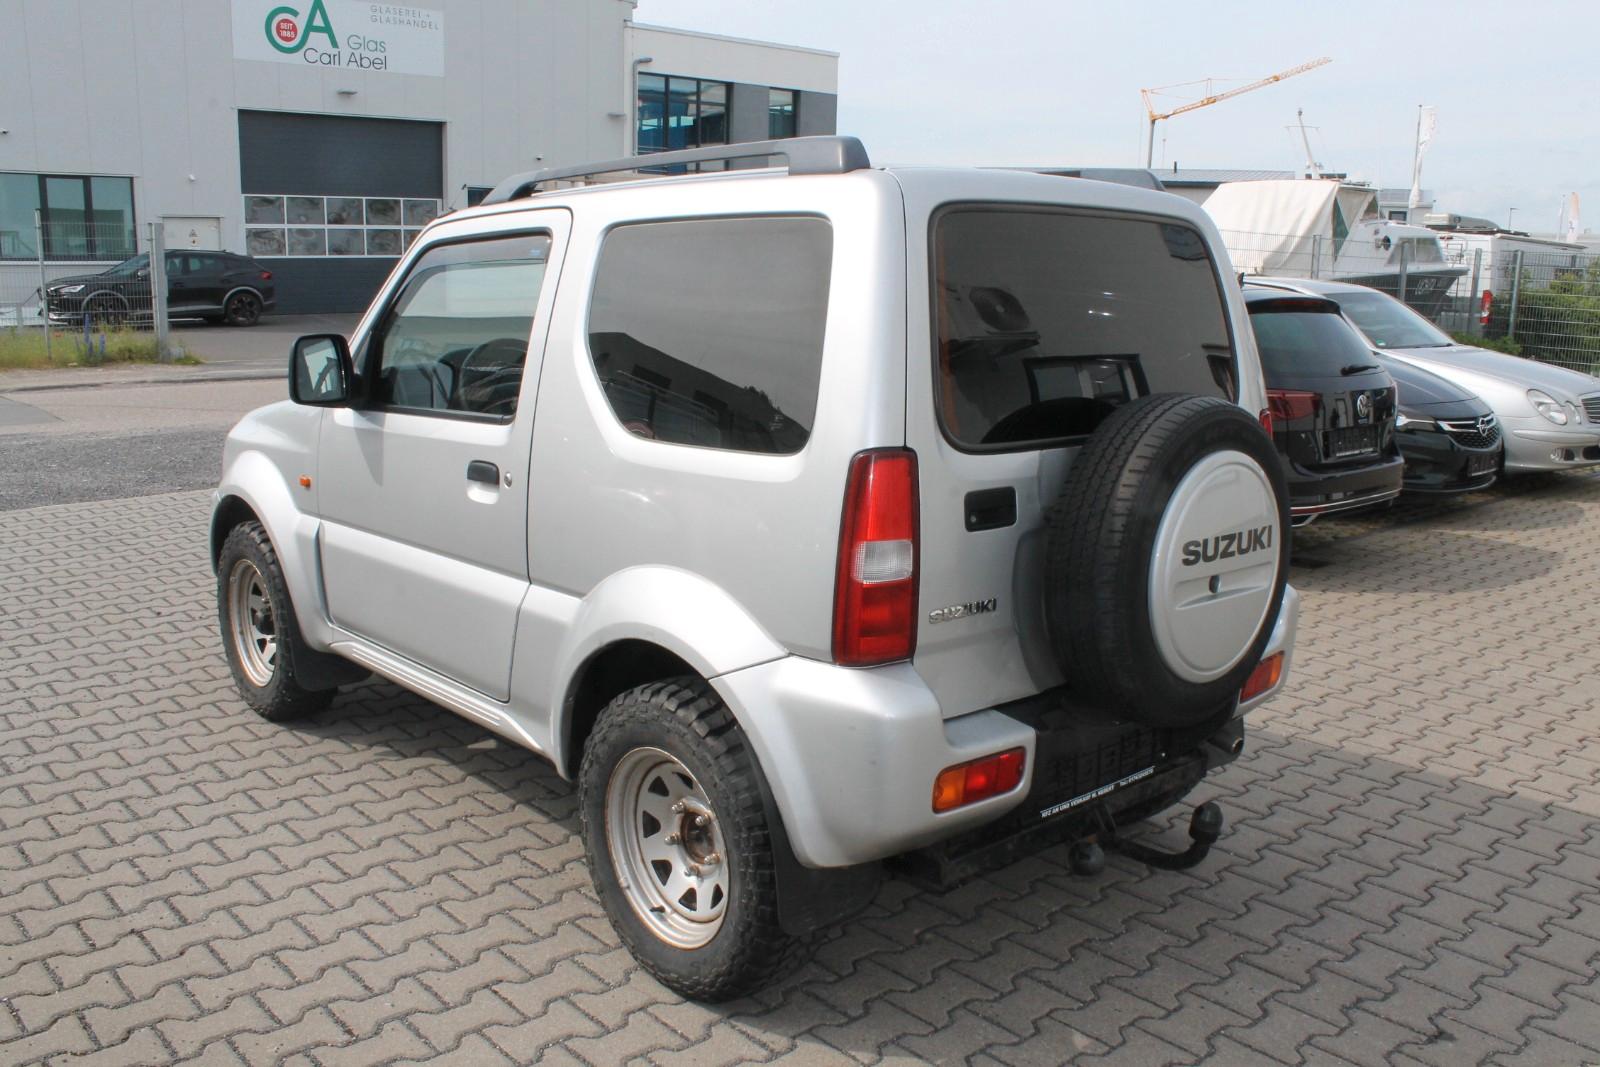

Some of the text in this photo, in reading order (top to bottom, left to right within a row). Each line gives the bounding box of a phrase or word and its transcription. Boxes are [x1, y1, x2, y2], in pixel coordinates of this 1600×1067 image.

[370, 5, 421, 18] GLASEREI
[280, 22, 293, 30] SEIT
[370, 14, 439, 30] GLASHANDEL
[347, 34, 387, 53] Glas
[303, 47, 387, 70] Carl Abel
[1182, 525, 1272, 566] SUZUKI
[928, 598, 997, 624] SUZUKI
